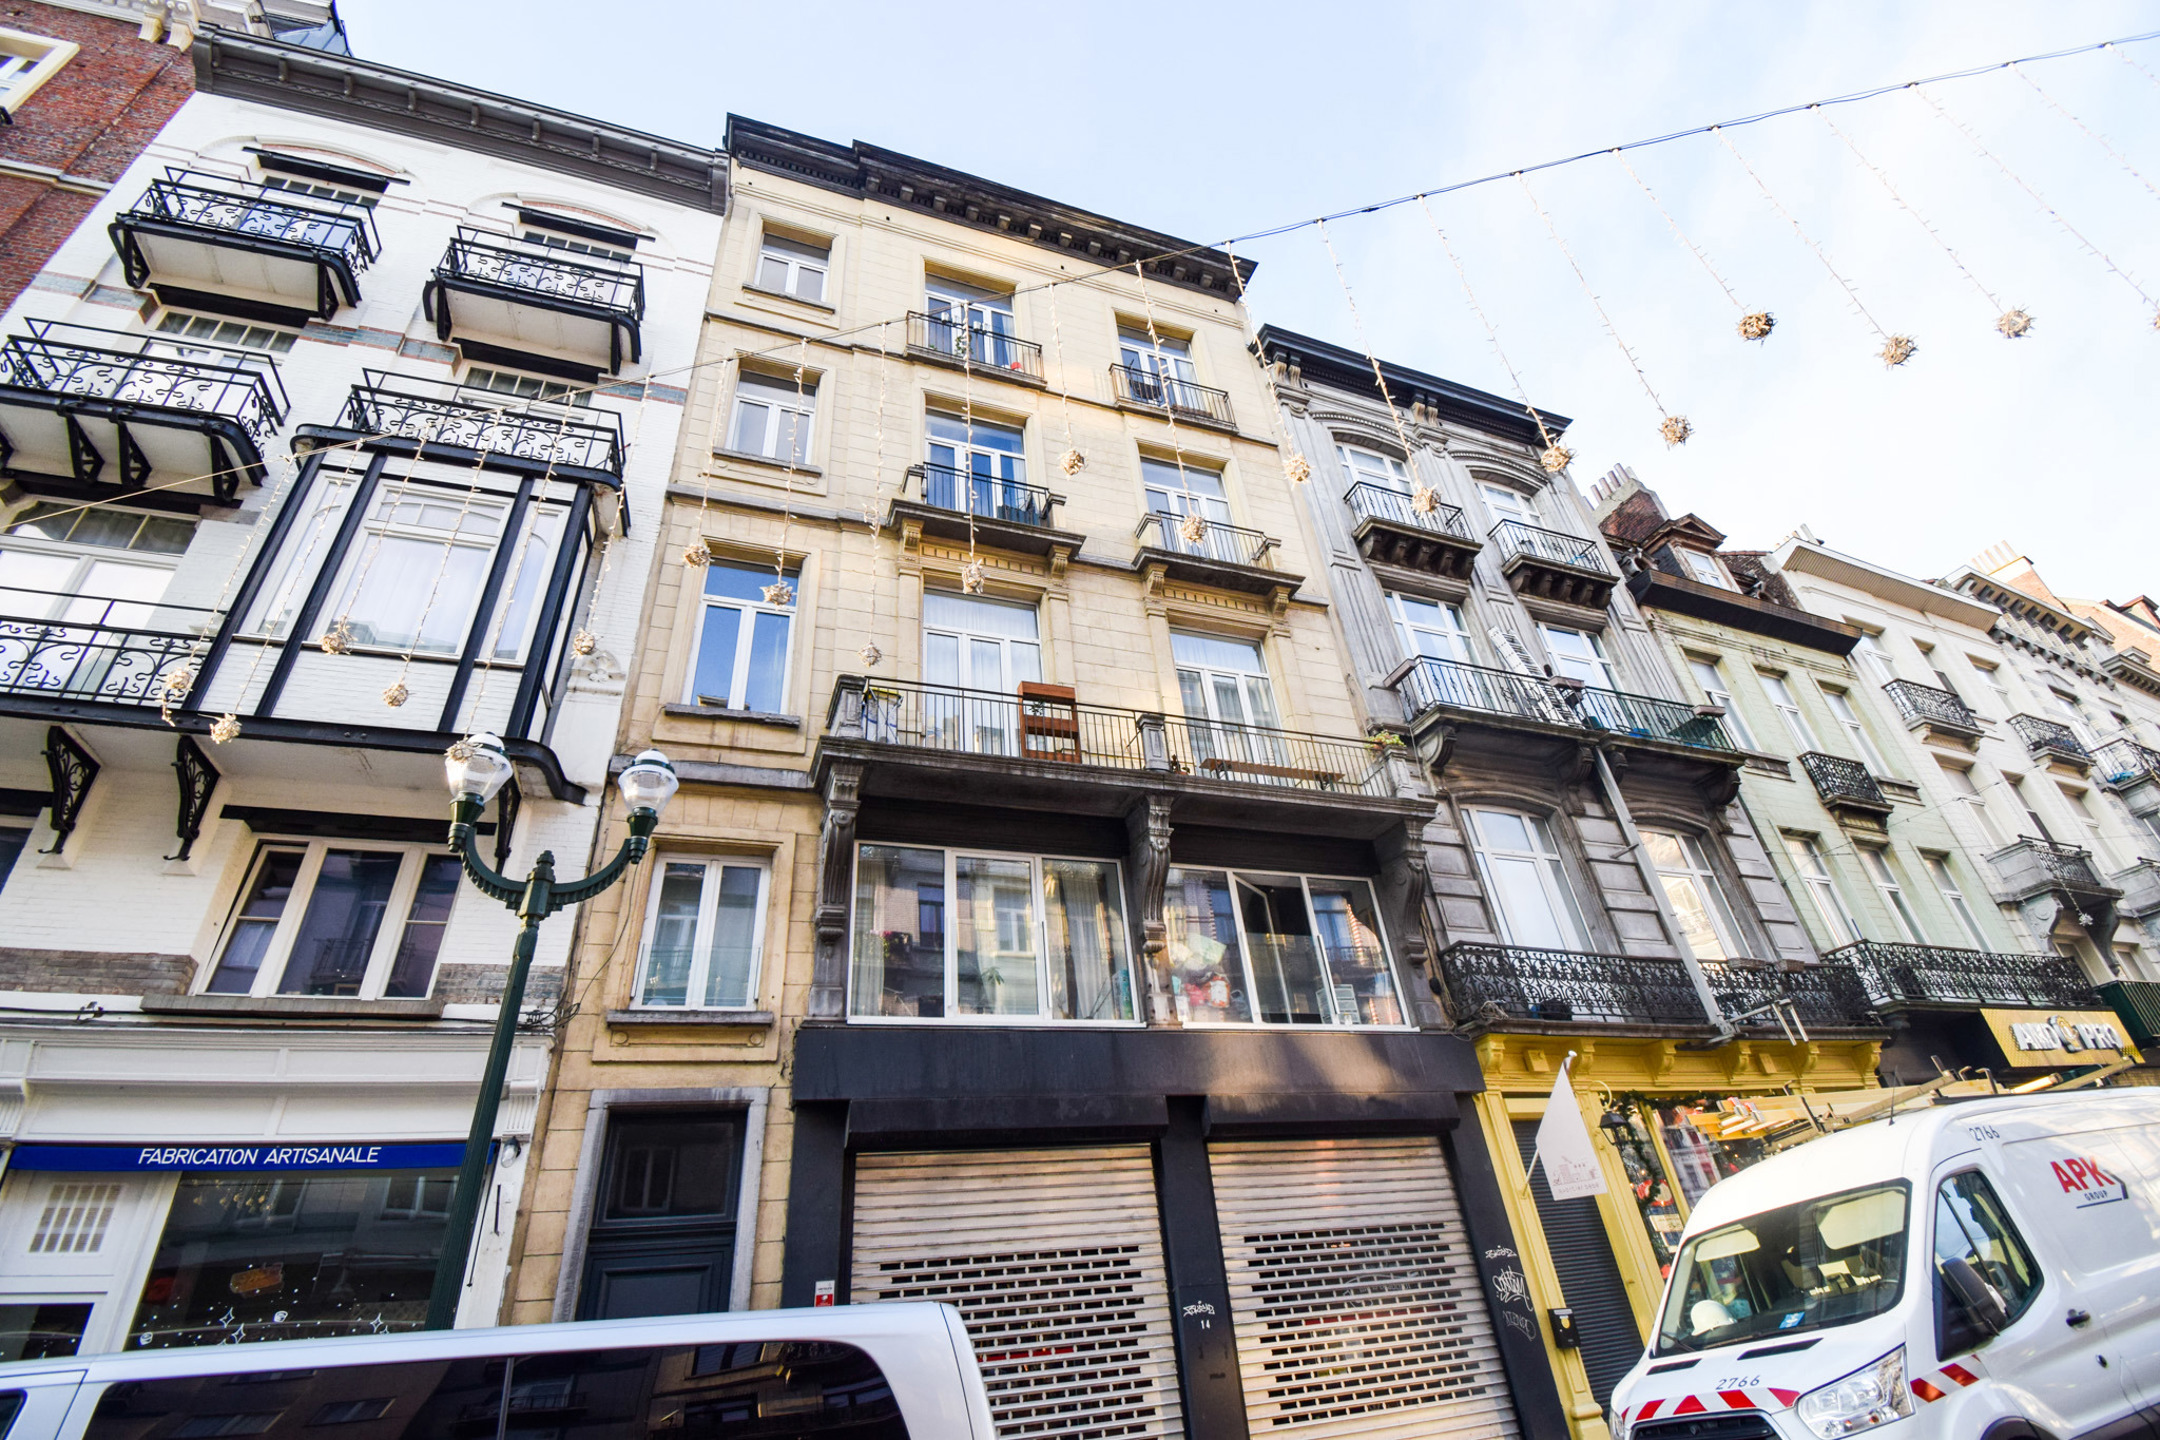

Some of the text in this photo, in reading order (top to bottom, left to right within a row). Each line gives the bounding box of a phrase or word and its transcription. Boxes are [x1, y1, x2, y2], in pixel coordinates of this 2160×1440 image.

[2074, 1023, 2123, 1050] PRO
[1969, 1125, 2000, 1141] 2766
[137, 1146, 382, 1165] FABRICATION ARTISANALE
[2050, 1155, 2116, 1193] APK
[2084, 1190, 2108, 1201] GROUP
[1715, 1374, 1761, 1390] 2766
